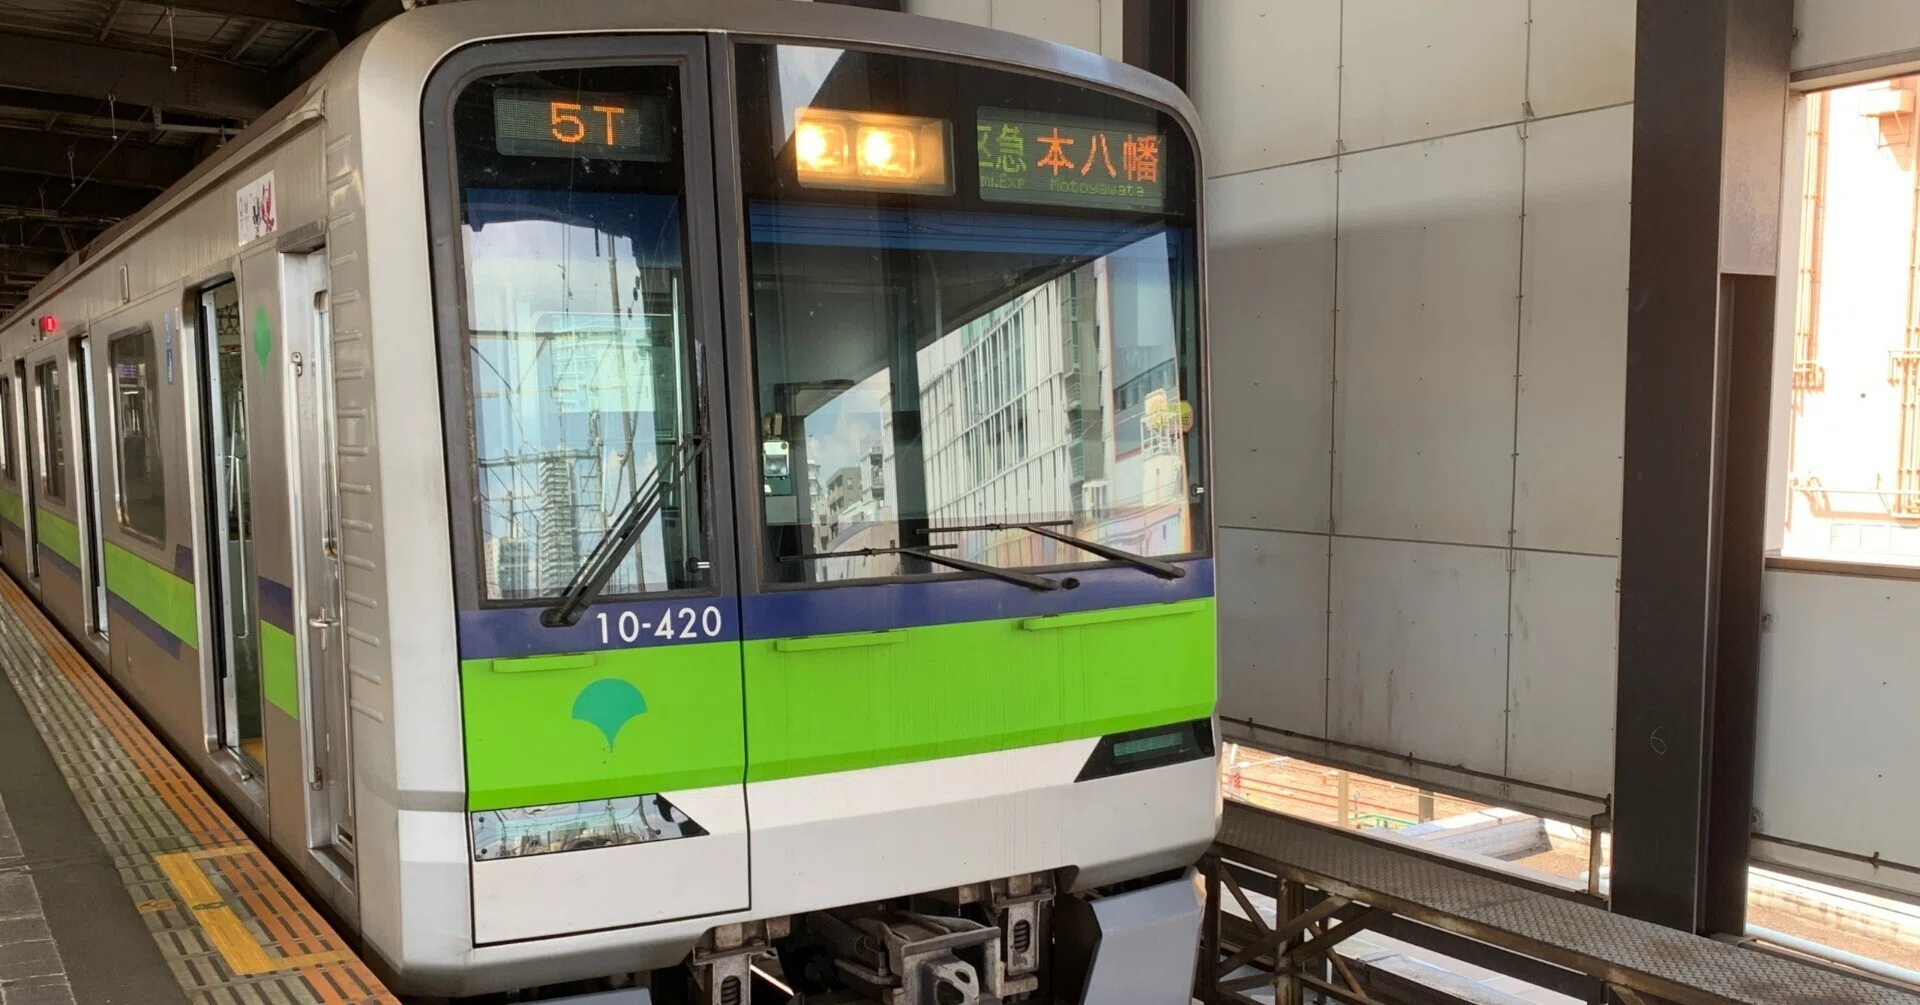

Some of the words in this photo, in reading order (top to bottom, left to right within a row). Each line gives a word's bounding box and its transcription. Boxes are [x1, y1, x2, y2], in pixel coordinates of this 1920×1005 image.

[550, 102, 625, 145] 5T
[1037, 128, 1158, 182] 本八幡
[596, 605, 722, 643] 10-420
